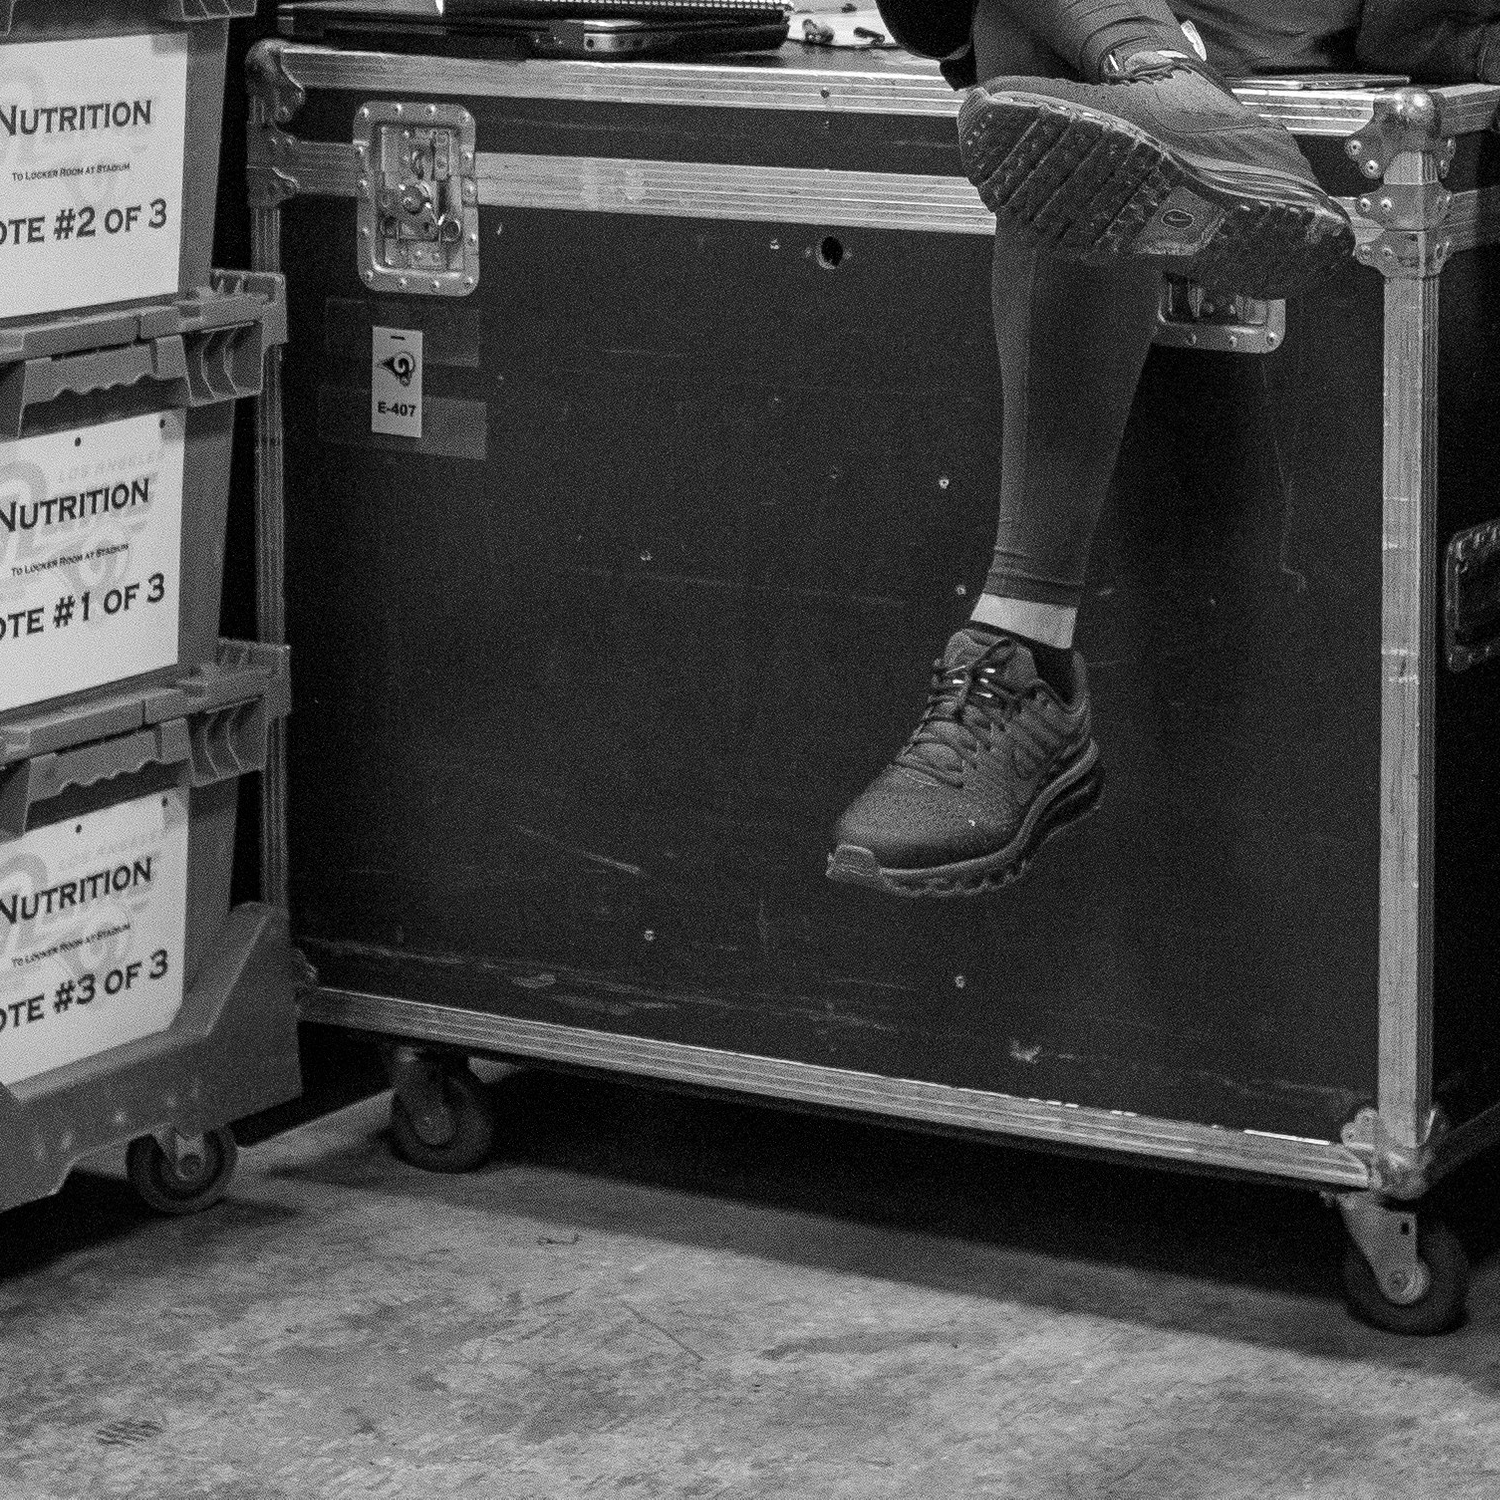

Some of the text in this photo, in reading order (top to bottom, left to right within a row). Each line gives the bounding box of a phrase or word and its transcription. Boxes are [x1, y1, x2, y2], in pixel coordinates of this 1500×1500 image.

[53, 206, 96, 240] #2
[104, 205, 141, 234] OF
[148, 198, 167, 229] 3
[377, 401, 416, 417] E-407
[53, 591, 90, 629] #1
[103, 583, 140, 615] OF
[147, 572, 165, 603] 3
[53, 974, 96, 1014] #3
[104, 962, 142, 996] OF
[149, 948, 168, 980] 3
